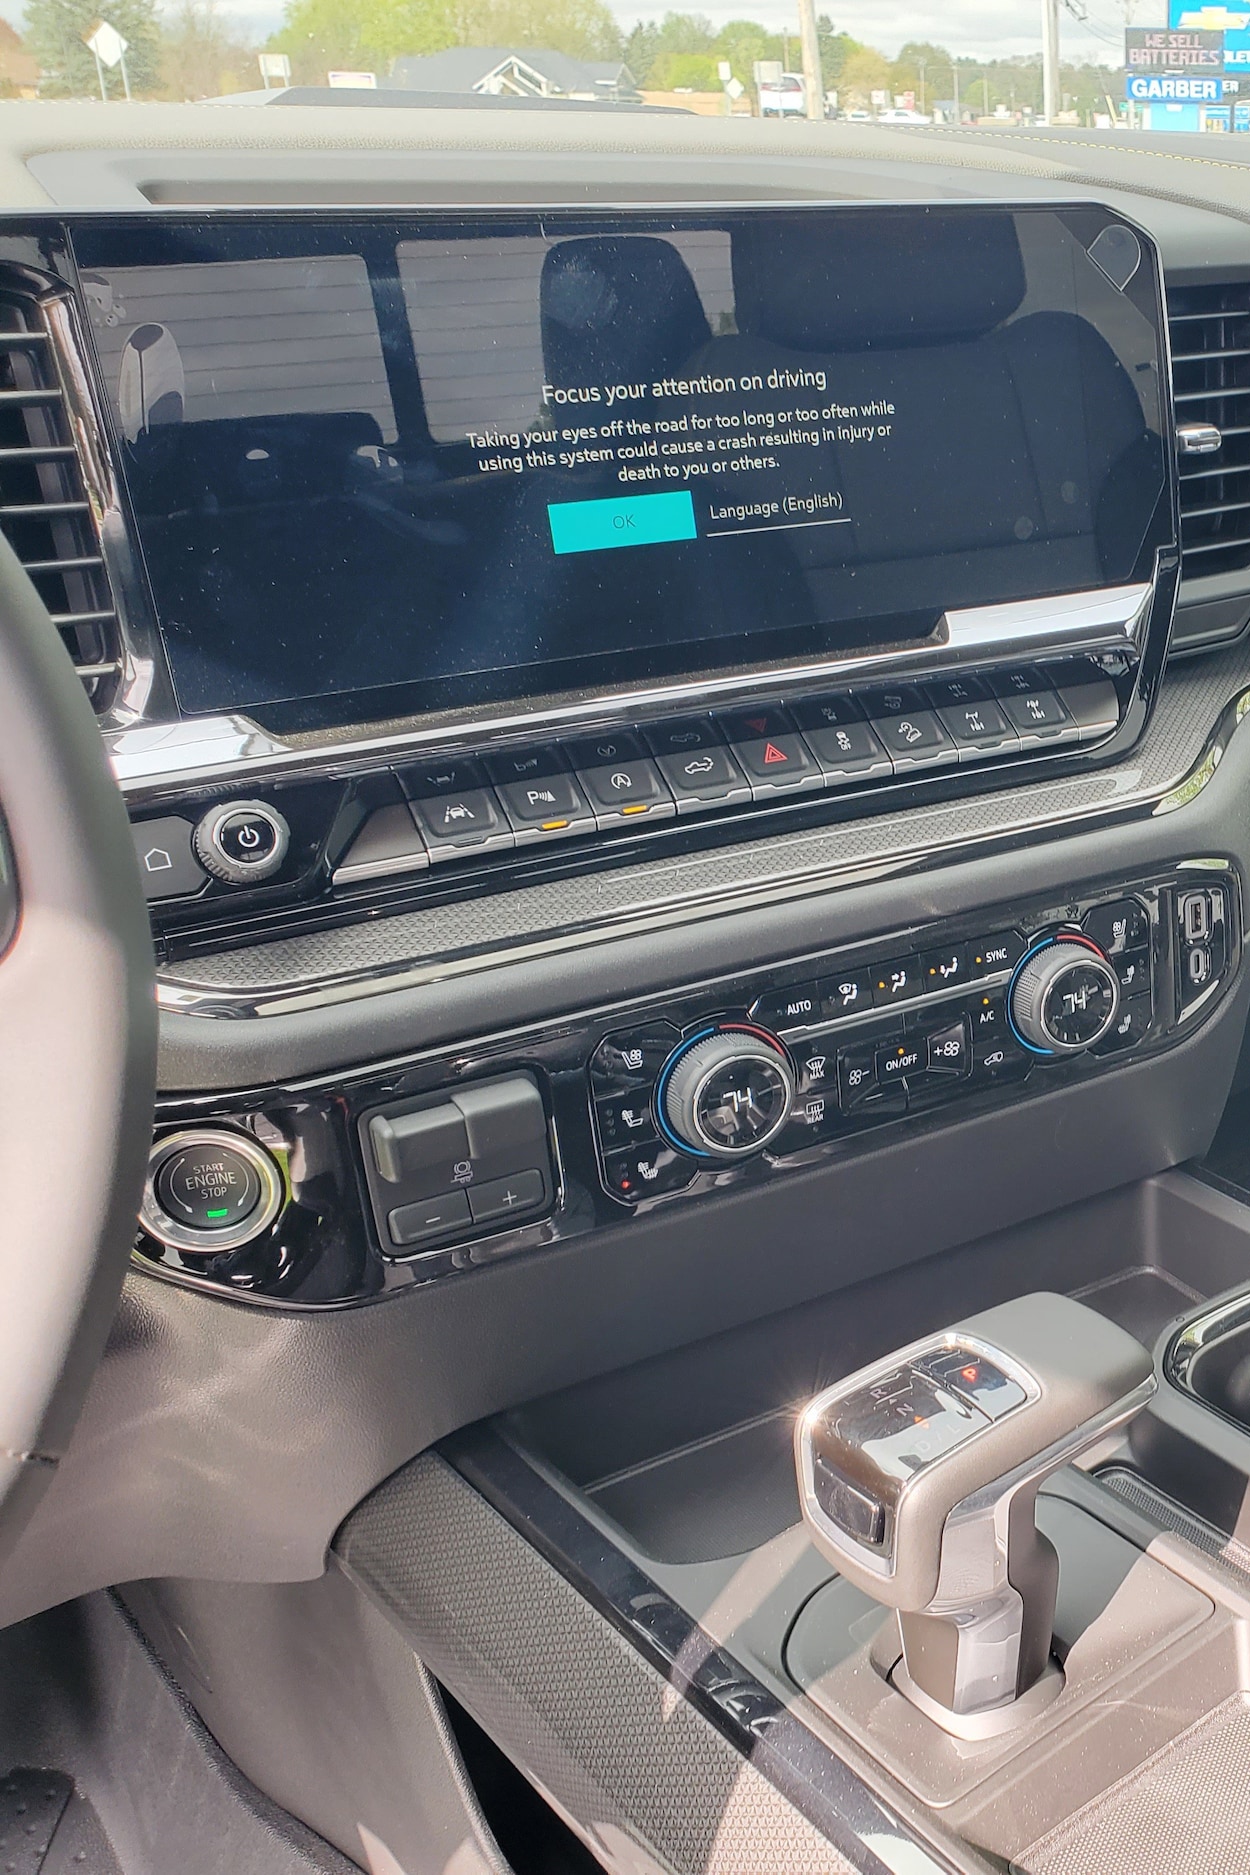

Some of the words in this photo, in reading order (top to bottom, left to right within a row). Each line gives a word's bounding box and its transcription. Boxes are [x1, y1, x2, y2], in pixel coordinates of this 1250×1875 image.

[1145, 34, 1165, 48] WE
[1169, 34, 1203, 48] SELL
[1129, 50, 1220, 65] BATTERIES
[1131, 79, 1217, 98] GARBER
[541, 384, 601, 405] Focus
[604, 383, 647, 406] your
[652, 374, 736, 397] attention
[740, 376, 763, 390] on
[767, 368, 827, 391] driving
[465, 430, 520, 449] Taking
[523, 429, 558, 446] your
[562, 427, 598, 444] eyes
[600, 419, 624, 437] off
[625, 419, 651, 435] the
[655, 415, 688, 433] road
[691, 413, 713, 431] for
[715, 415, 740, 428] too
[743, 410, 775, 428] long
[777, 411, 793, 423] or
[795, 408, 819, 421] too
[821, 403, 858, 420] often
[860, 399, 896, 416] while
[478, 454, 523, 473] using
[526, 448, 556, 467] this
[559, 447, 614, 468] system
[617, 440, 658, 460] could
[661, 442, 704, 455] cause
[706, 439, 716, 451] a
[718, 432, 757, 451] crash
[759, 428, 820, 447] resulting
[822, 426, 836, 441] in
[838, 423, 875, 443] injury
[877, 423, 892, 436] or
[617, 463, 661, 482] death
[664, 463, 680, 478] to
[682, 463, 709, 480] you
[711, 460, 728, 473] or
[730, 454, 780, 472] others.
[710, 501, 779, 521] Language
[782, 492, 843, 516] (English)
[612, 515, 636, 529] OK
[985, 948, 1008, 963] SYNC
[787, 1000, 812, 1016] AUTO
[1063, 991, 1087, 1014] 74
[979, 1010, 995, 1024] A/C
[886, 1053, 917, 1072] ON/OFF
[810, 1070, 825, 1080] MAX
[723, 1087, 752, 1112] 74
[807, 1114, 824, 1124] REAR
[193, 1163, 224, 1174] START
[185, 1172, 237, 1190] ENGINE
[201, 1186, 227, 1199] STOP
[961, 1366, 977, 1383] P
[870, 1388, 887, 1399] R
[896, 1403, 914, 1417] N
